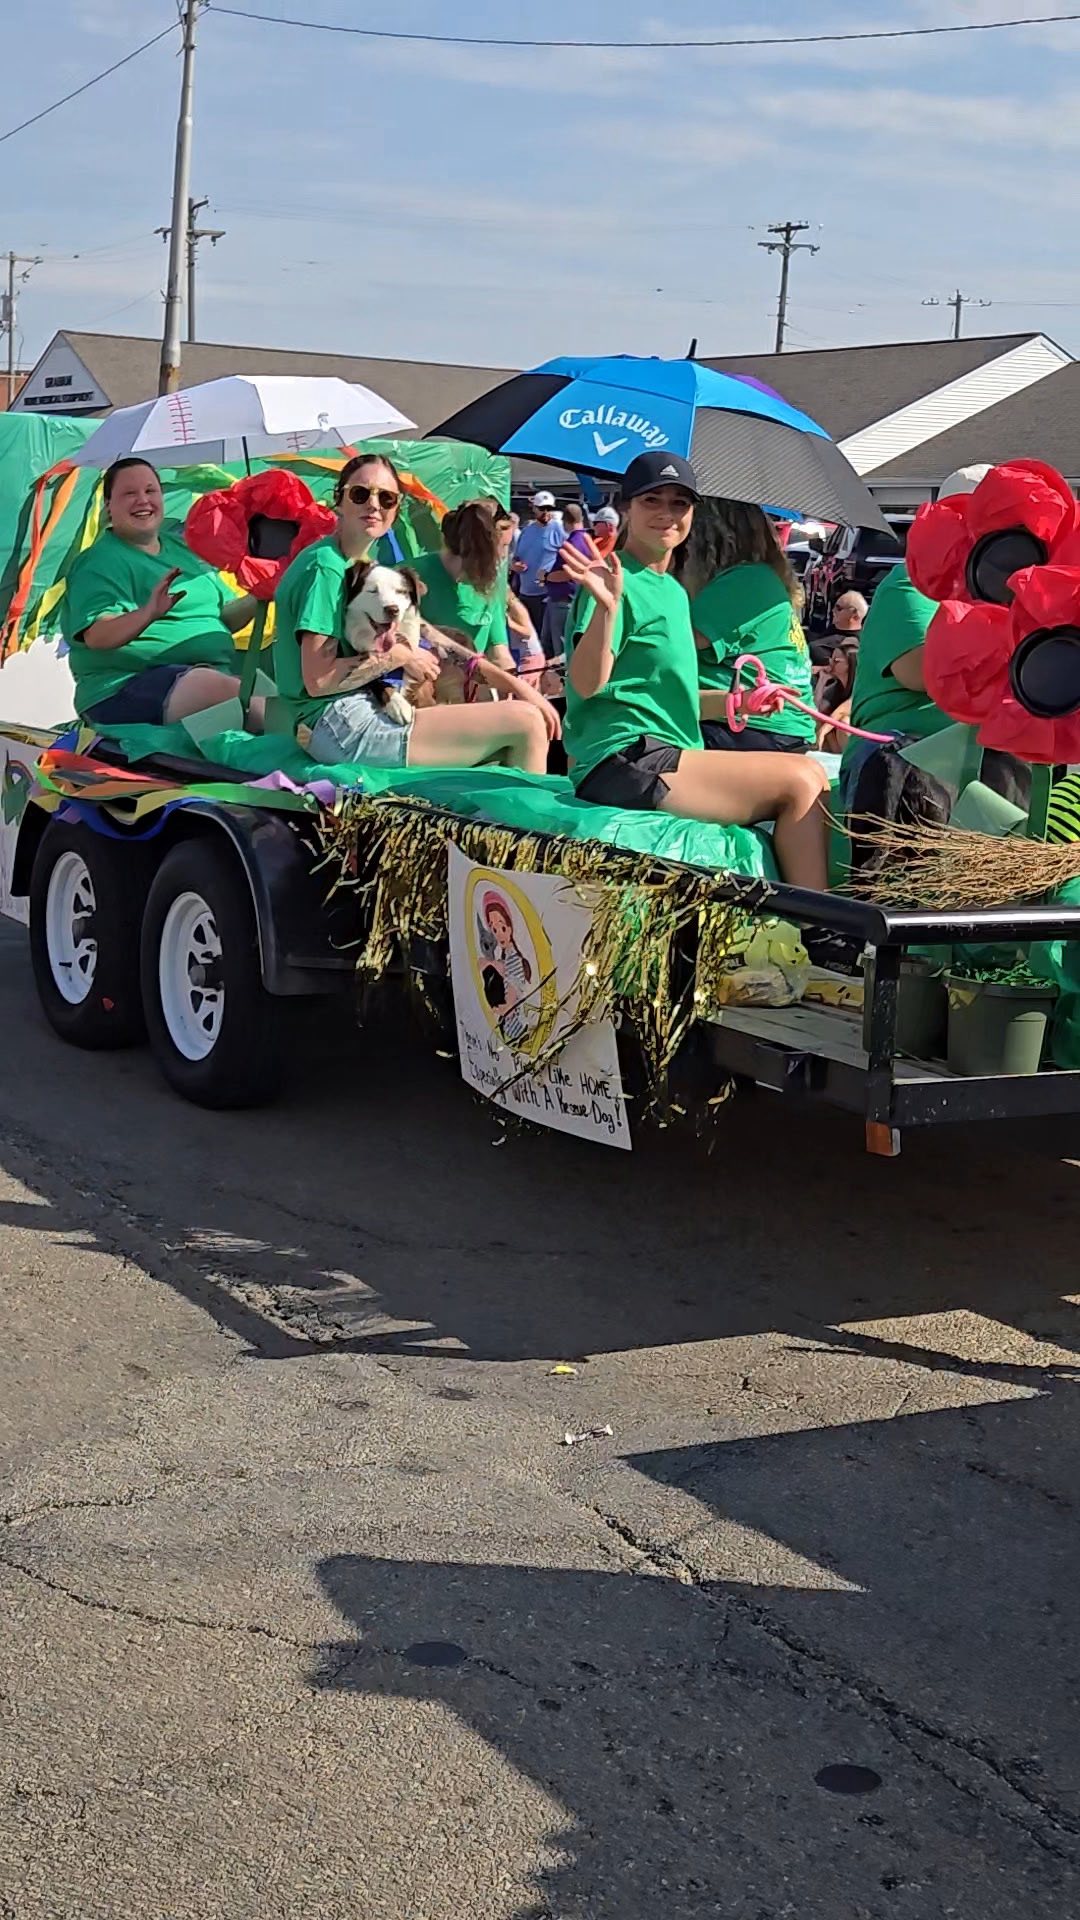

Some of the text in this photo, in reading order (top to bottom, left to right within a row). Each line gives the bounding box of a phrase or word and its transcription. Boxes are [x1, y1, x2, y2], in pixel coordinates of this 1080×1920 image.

[559, 404, 669, 447] Callaway
[548, 1063, 573, 1087] Like
[512, 1079, 541, 1107] With
[543, 1084, 554, 1110] A
[591, 1094, 622, 1134] Dog!
